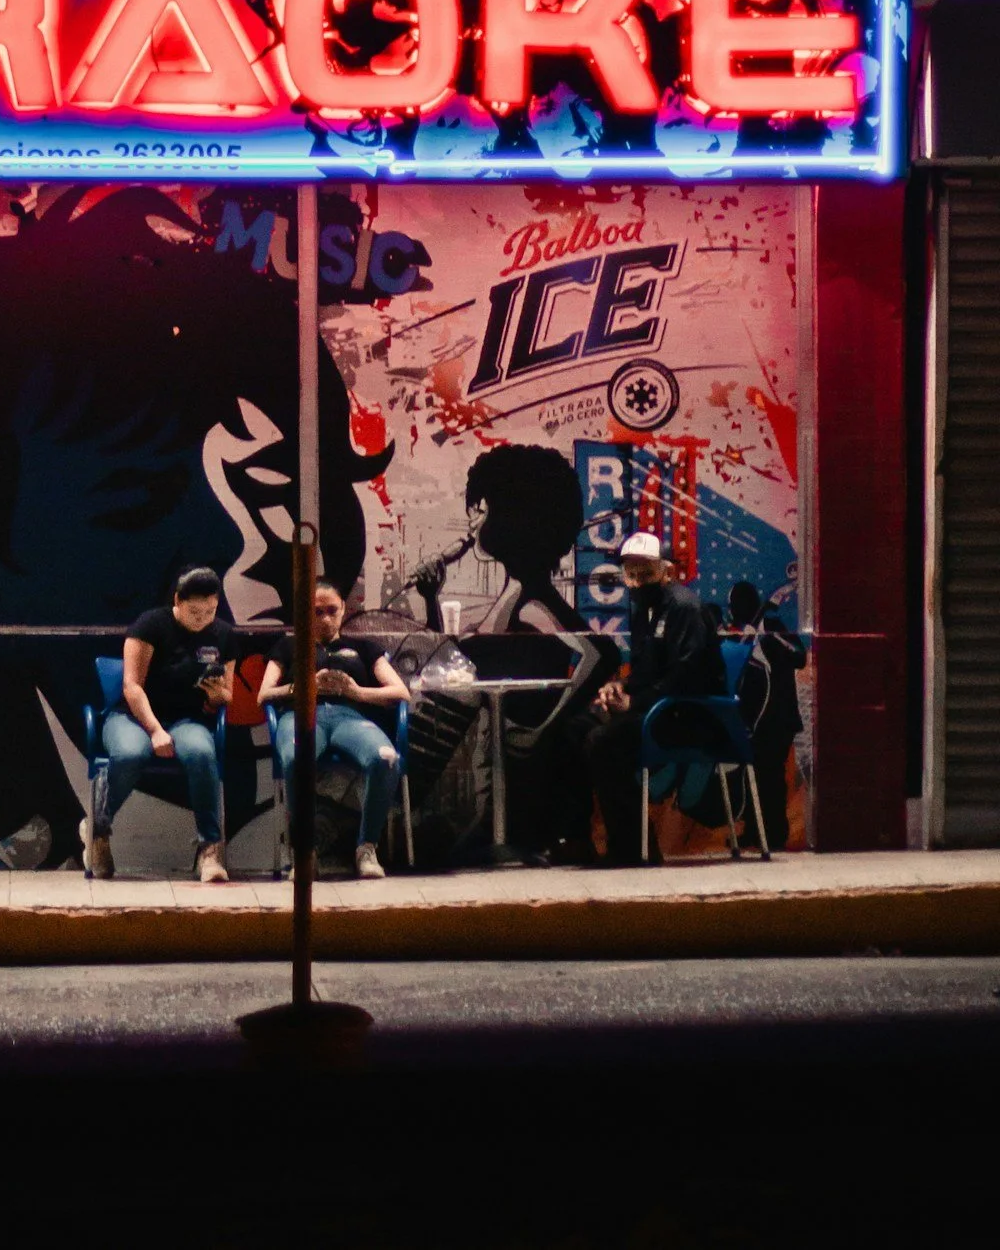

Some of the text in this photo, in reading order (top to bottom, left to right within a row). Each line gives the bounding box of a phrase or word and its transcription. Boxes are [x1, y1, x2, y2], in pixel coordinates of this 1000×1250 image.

[499, 213, 647, 277] Balboa
[467, 240, 686, 396] ICE
[538, 396, 602, 422] FILTRADA
[545, 406, 605, 431] BAJO CERO
